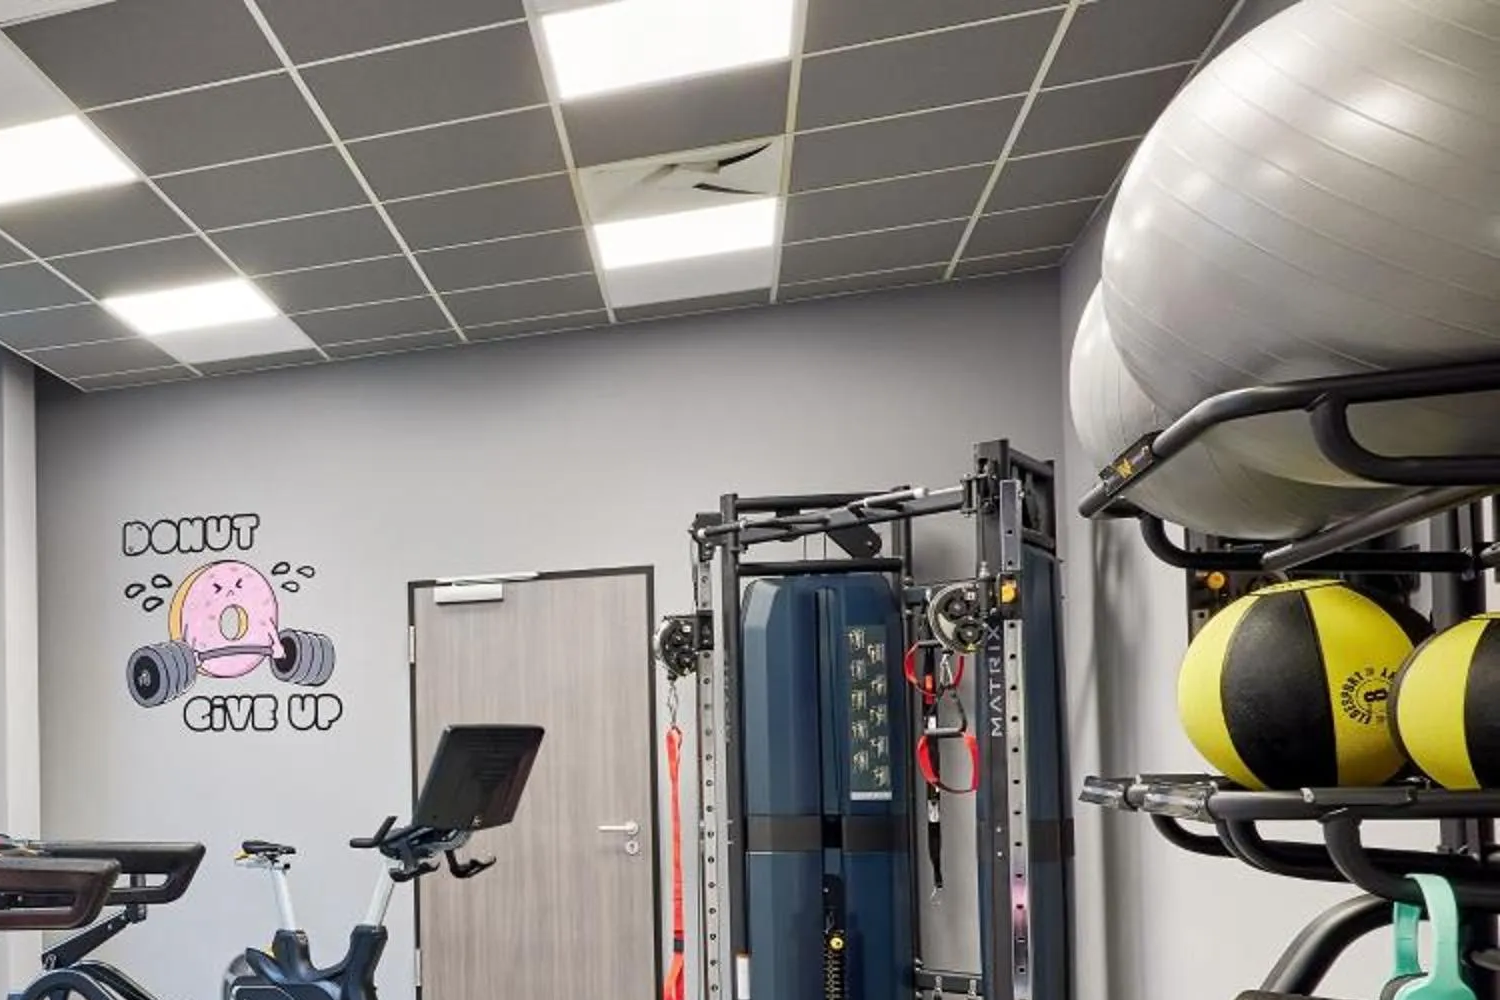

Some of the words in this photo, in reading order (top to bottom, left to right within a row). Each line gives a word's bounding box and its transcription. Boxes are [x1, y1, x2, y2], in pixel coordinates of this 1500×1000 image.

[122, 513, 260, 556] DONUT
[987, 625, 1003, 737] MATRIX
[287, 693, 343, 730] UP
